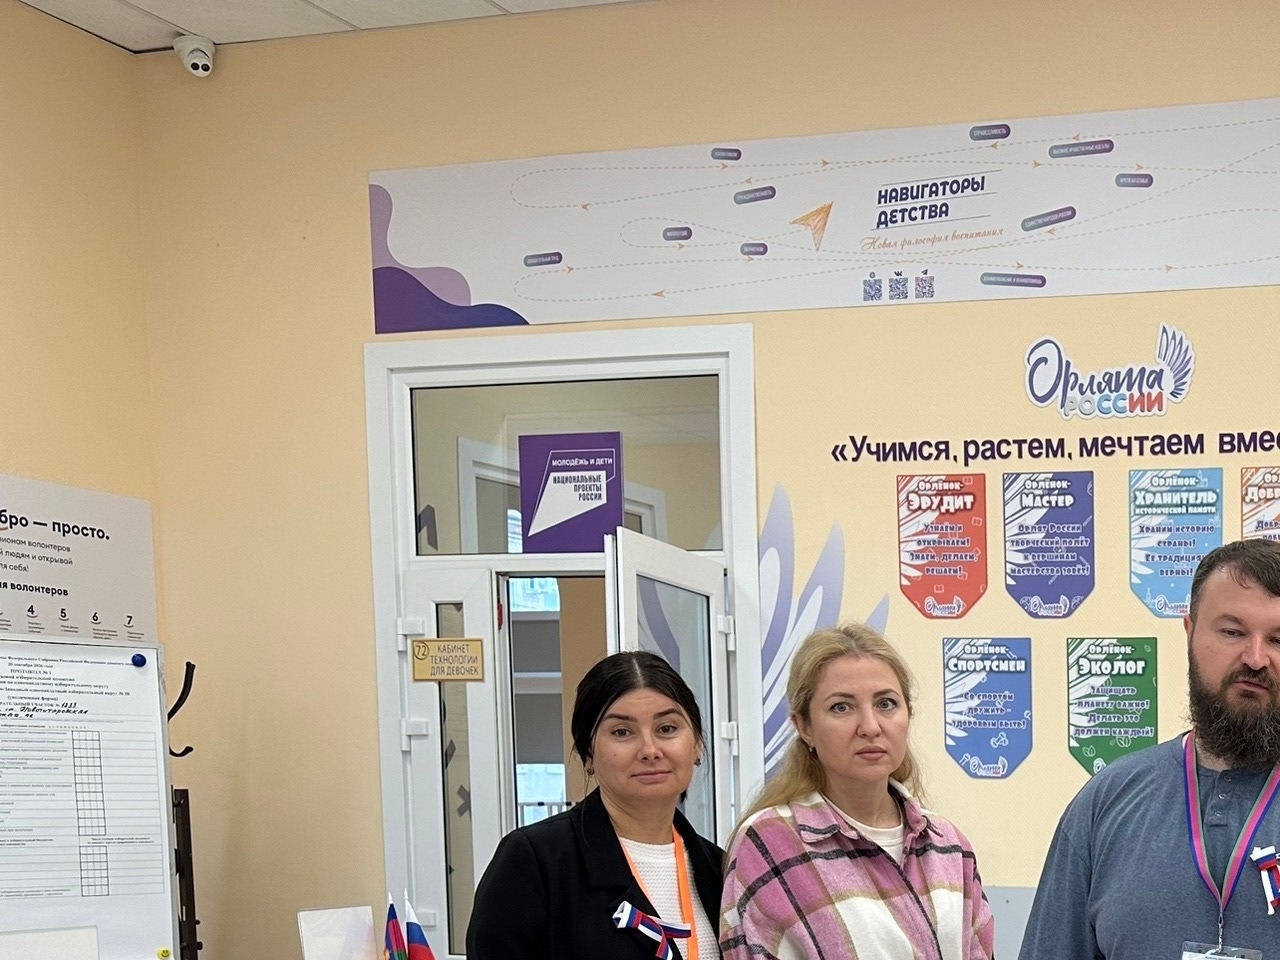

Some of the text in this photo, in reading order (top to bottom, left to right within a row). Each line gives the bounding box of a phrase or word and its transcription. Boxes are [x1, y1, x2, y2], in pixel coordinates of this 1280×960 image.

[877, 176, 985, 205] НАВИГАТОРЫ
[876, 202, 949, 228] ДЕТСТВА
[900, 234, 948, 250] философия
[951, 228, 1004, 241] воспитания
[1027, 339, 1165, 410] Орлята
[1064, 391, 1164, 416] РОССИИ
[831, 435, 958, 463] «Учимся,
[963, 437, 1073, 467] растем,
[1079, 433, 1205, 458] мечтаем
[596, 458, 613, 466] ДЕТИ
[553, 475, 602, 484] НАЦИОНАЛЬНЫЕ
[574, 484, 602, 492] ПРОЕКТЫ
[579, 493, 602, 501] РОССИИ
[52, 521, 110, 540] просто.
[28, 541, 71, 552] волонтеров
[37, 555, 73, 565] открывай
[10, 582, 69, 597] волонтеров
[27, 604, 133, 626] 4 5 6 7
[416, 644, 427, 657] 72
[437, 644, 470, 654] КАБИНЕТ
[430, 655, 478, 665] ТЕХНОЛОГИИ
[430, 666, 479, 676] ДЛЯ ДЕВОЧЕК
